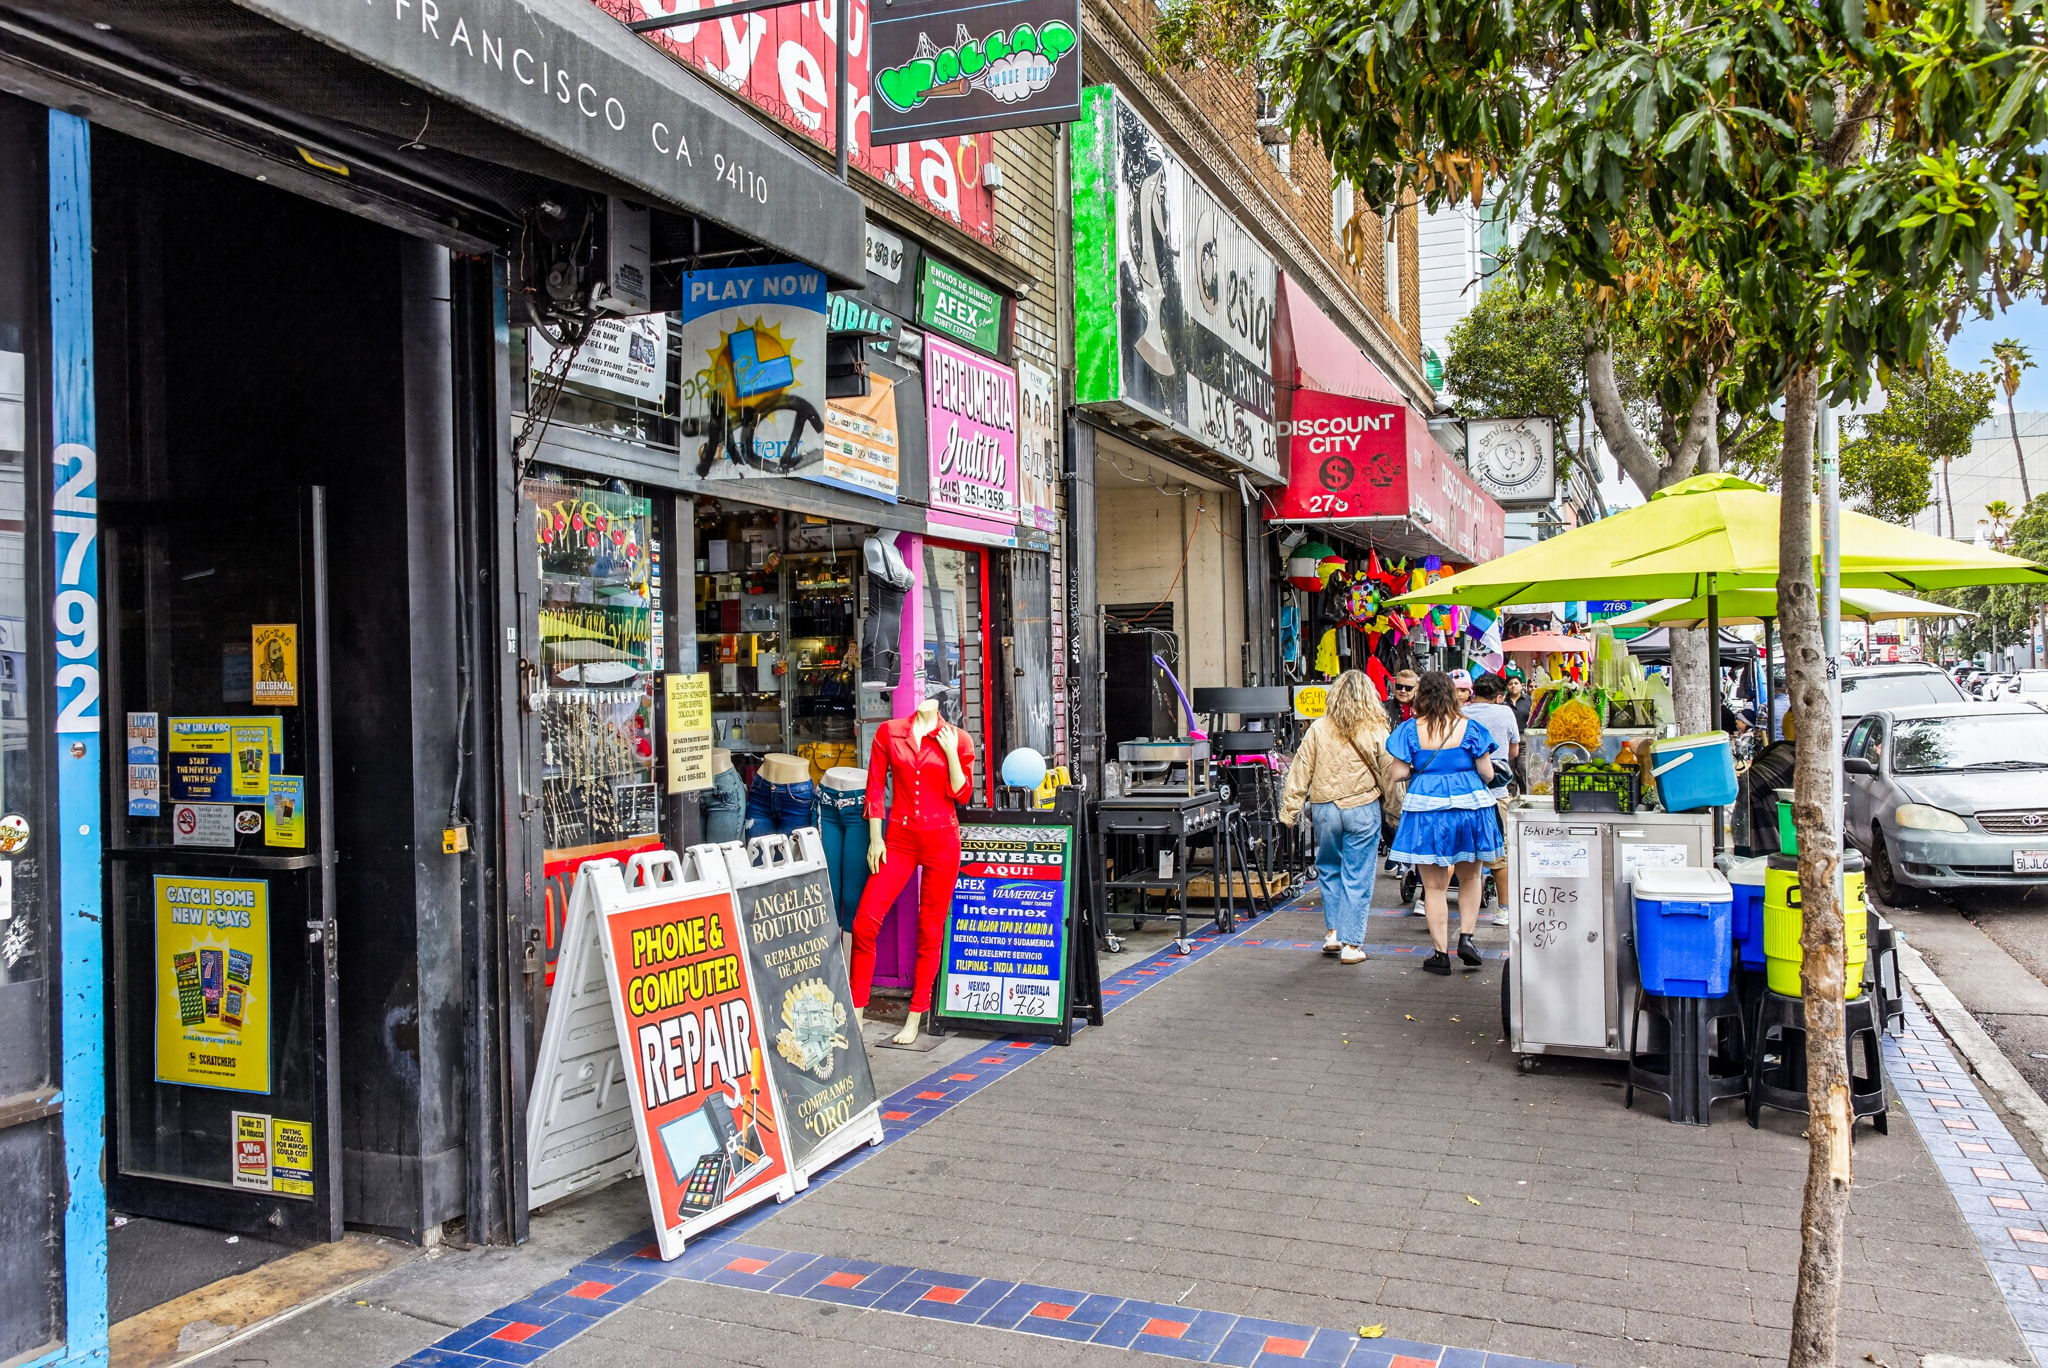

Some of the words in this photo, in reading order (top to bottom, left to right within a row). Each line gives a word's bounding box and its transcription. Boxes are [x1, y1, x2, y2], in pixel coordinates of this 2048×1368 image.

[987, 68, 1019, 89] SMOKE
[652, 121, 692, 167] CA
[714, 154, 767, 204] 94110
[691, 278, 754, 303] PLAY
[763, 274, 819, 298] NOW
[930, 265, 958, 287] ENVIOS
[958, 281, 968, 293] DE
[968, 284, 993, 305] DINERO
[935, 292, 979, 328] AFEX
[933, 315, 953, 330] MONEY
[953, 323, 976, 341] EXPRESS
[932, 350, 1014, 434] PERFUMERIA
[1277, 413, 1395, 438] DISCOUNT
[1309, 435, 1361, 454] CITY
[1480, 424, 1511, 448] Smile
[1515, 425, 1543, 461] Center
[940, 418, 1007, 488] Judith
[938, 478, 961, 504] (415)
[964, 482, 1005, 511] 251-1358
[52, 443, 100, 733] 2792
[1603, 602, 1627, 611] 2766
[256, 681, 294, 690] ORIGINAL
[134, 715, 156, 728] LUCKY
[174, 723, 191, 732] PLAY
[215, 723, 230, 732] PRO
[128, 728, 157, 739] RETAILER
[189, 757, 209, 765] START
[136, 766, 157, 780] LUCKY
[177, 766, 188, 774] THE
[189, 766, 204, 774] NEW
[205, 766, 222, 774] YEAR
[130, 779, 158, 790] RETAILER
[182, 775, 199, 783] WITH
[960, 840, 1028, 851] ENVIOS
[1034, 842, 1062, 852] DE
[960, 851, 1063, 864] DINERO
[983, 865, 1034, 877] AQUI!
[954, 878, 986, 890] AFEX
[165, 886, 210, 904] CATCH
[214, 888, 255, 907] SOME
[752, 882, 823, 922] ANGELA'S
[992, 889, 1056, 901] VIAMERICAS
[172, 906, 203, 925] NEW
[206, 908, 251, 929] PLAYS
[963, 904, 1047, 918] Intermex
[1536, 907, 1555, 917] en
[750, 906, 831, 946] BOUTIQUE
[956, 918, 969, 931] CON
[969, 919, 976, 931] EL
[977, 919, 999, 932] MEJOR
[999, 921, 1013, 933] TIPO
[1014, 921, 1023, 934] DE
[1024, 922, 1047, 935] CAMBIO
[1048, 923, 1054, 935] A
[632, 918, 706, 970] PHONE
[708, 912, 724, 950] &
[953, 934, 979, 944] MEXICO,
[980, 936, 1006, 945] CENTRO
[1007, 938, 1013, 946] Y
[1013, 938, 1055, 948] SUDAMERICA
[763, 936, 830, 969] REPARACION
[964, 948, 979, 957] CON
[979, 949, 1011, 959] EXELENTE
[1012, 951, 1043, 960] SERVICIO
[778, 965, 794, 980] DE
[793, 954, 823, 976] JOYAS
[955, 959, 989, 972] FILIPINAS
[993, 961, 1014, 974] INDIA
[1017, 963, 1022, 974] Y
[1022, 964, 1049, 976] ARABIA
[628, 955, 741, 1018] COMPUTER
[955, 983, 960, 996] $
[968, 981, 991, 992] MEXICO
[1008, 987, 1014, 1000] $
[1015, 983, 1050, 997] GUATEMALA
[1013, 995, 1046, 1017] 7.63
[198, 1053, 237, 1068] SCRATCHERS
[638, 998, 753, 1111] REPAIR
[797, 1075, 854, 1117] COMPRAMOS
[241, 1119, 255, 1128] Under
[246, 1129, 264, 1138] Tobacco
[280, 1134, 304, 1143] TOBACCO
[282, 1128, 302, 1136] BUYING
[242, 1142, 260, 1154] We
[277, 1148, 294, 1156] COULD
[295, 1150, 308, 1158] COST
[288, 1143, 308, 1151] MINORS
[239, 1153, 265, 1164] Card
